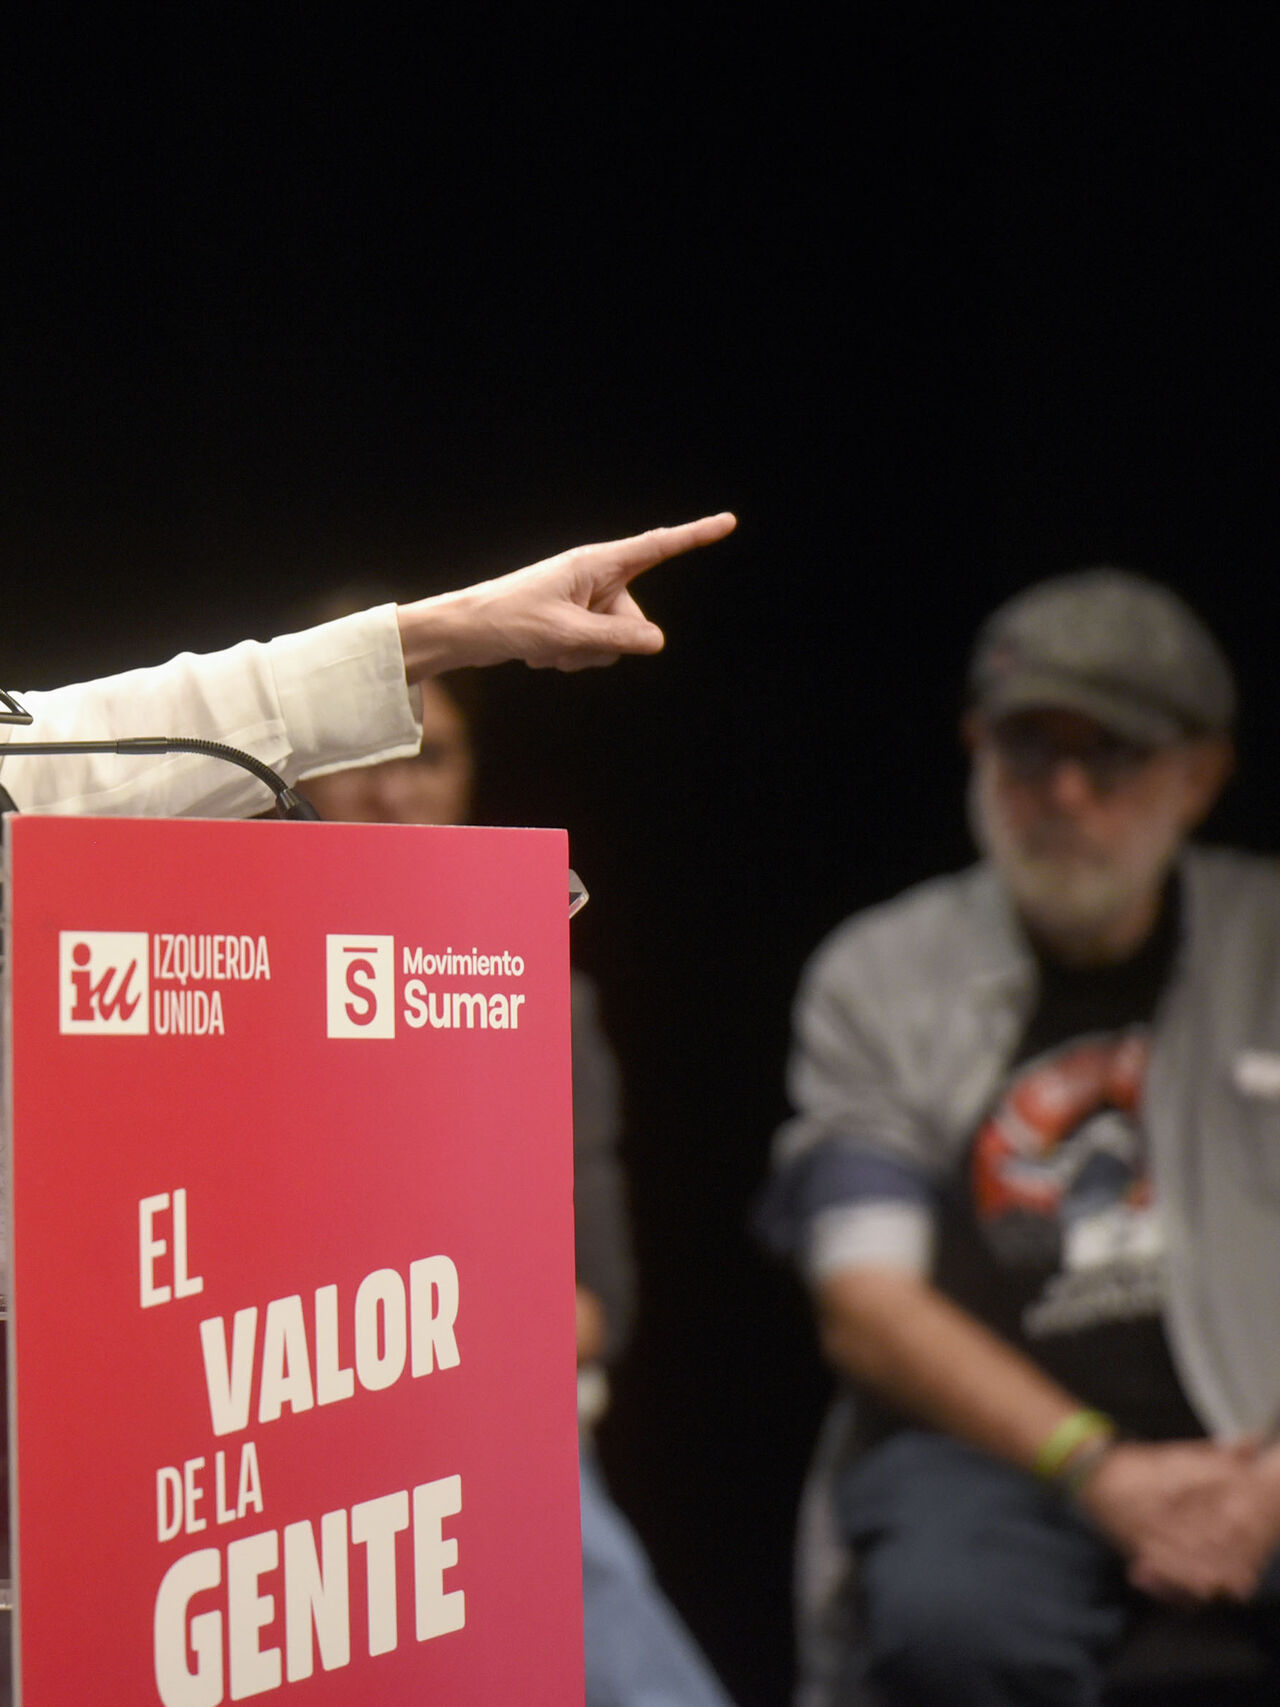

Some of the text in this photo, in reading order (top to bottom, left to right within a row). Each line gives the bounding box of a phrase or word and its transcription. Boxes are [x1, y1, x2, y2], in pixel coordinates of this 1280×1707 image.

[70, 941, 142, 1021] iu
[153, 934, 271, 985] IZQUIERDA
[403, 946, 525, 976] Movimiento
[154, 990, 225, 1036] UNIDA
[403, 979, 526, 1030] Sumar
[138, 1187, 204, 1309] EL
[200, 1254, 461, 1437] VALOR
[156, 1441, 264, 1543] DE LA
[153, 1473, 466, 1707] GENTE
